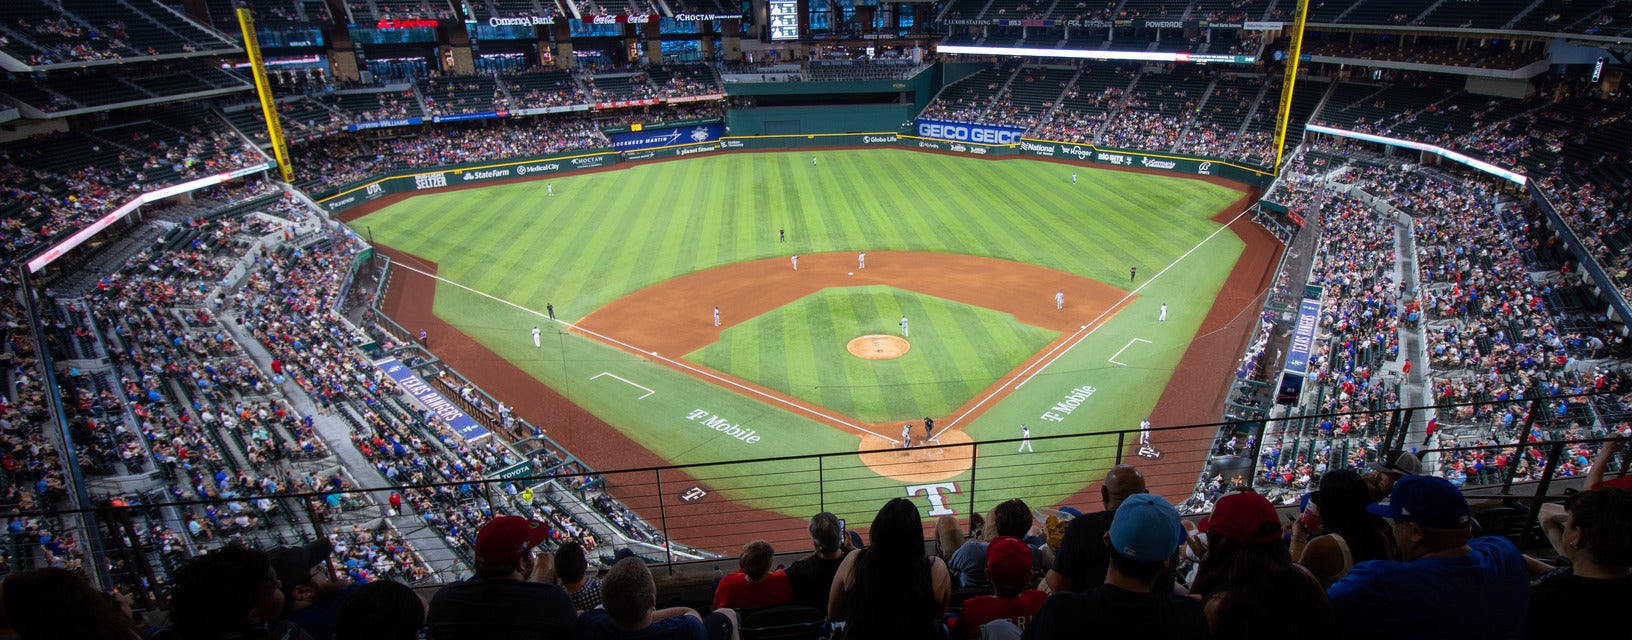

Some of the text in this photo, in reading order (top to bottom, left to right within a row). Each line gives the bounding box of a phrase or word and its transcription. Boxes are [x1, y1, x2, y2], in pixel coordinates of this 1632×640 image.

[532, 16, 555, 25] Bank
[1145, 21, 1183, 29] POWERADE
[919, 123, 968, 141] GEICO
[613, 139, 644, 147] LOCKHEED
[1028, 143, 1055, 152] National
[681, 148, 698, 156] planet
[1070, 146, 1092, 159] Kroger
[1098, 153, 1124, 162] BIG BITE
[527, 163, 560, 173] Medical City
[366, 183, 382, 195] UTA
[416, 177, 447, 190] SELTZER
[400, 375, 463, 422] TEXAS RANGERS
[1052, 385, 1097, 415] Mobile
[700, 415, 761, 444] Mobile
[502, 465, 530, 479] TOYOTA
[905, 481, 963, 517] T
